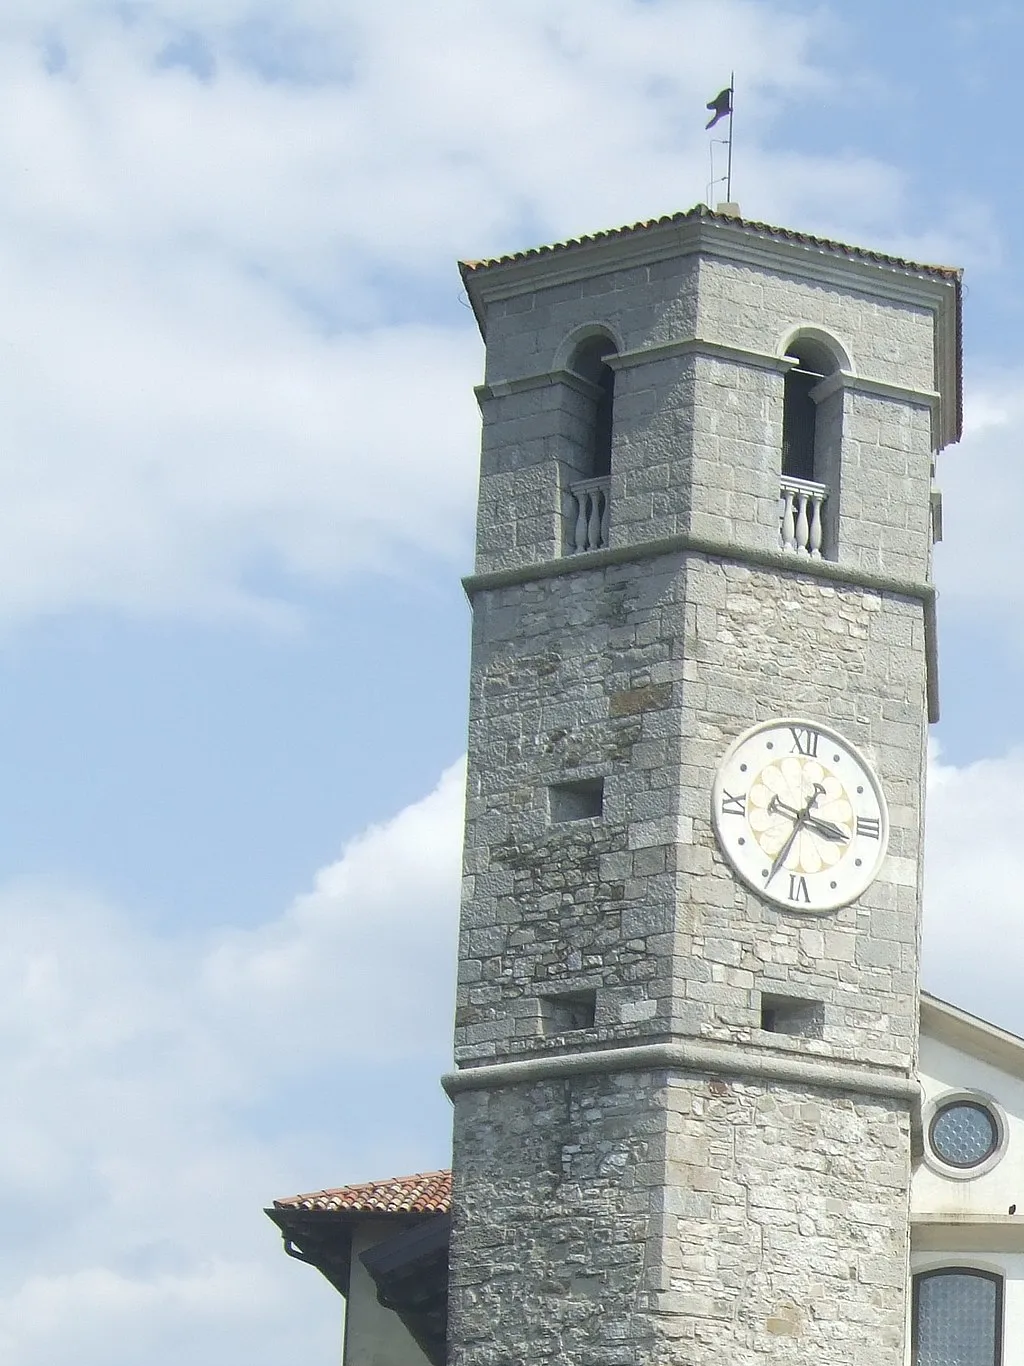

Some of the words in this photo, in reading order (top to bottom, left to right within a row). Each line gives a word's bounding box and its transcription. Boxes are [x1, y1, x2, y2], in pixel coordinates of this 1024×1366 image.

[789, 728, 820, 757] XII
[722, 789, 746, 817] IX
[856, 816, 880, 840] III
[788, 874, 810, 903] VI
